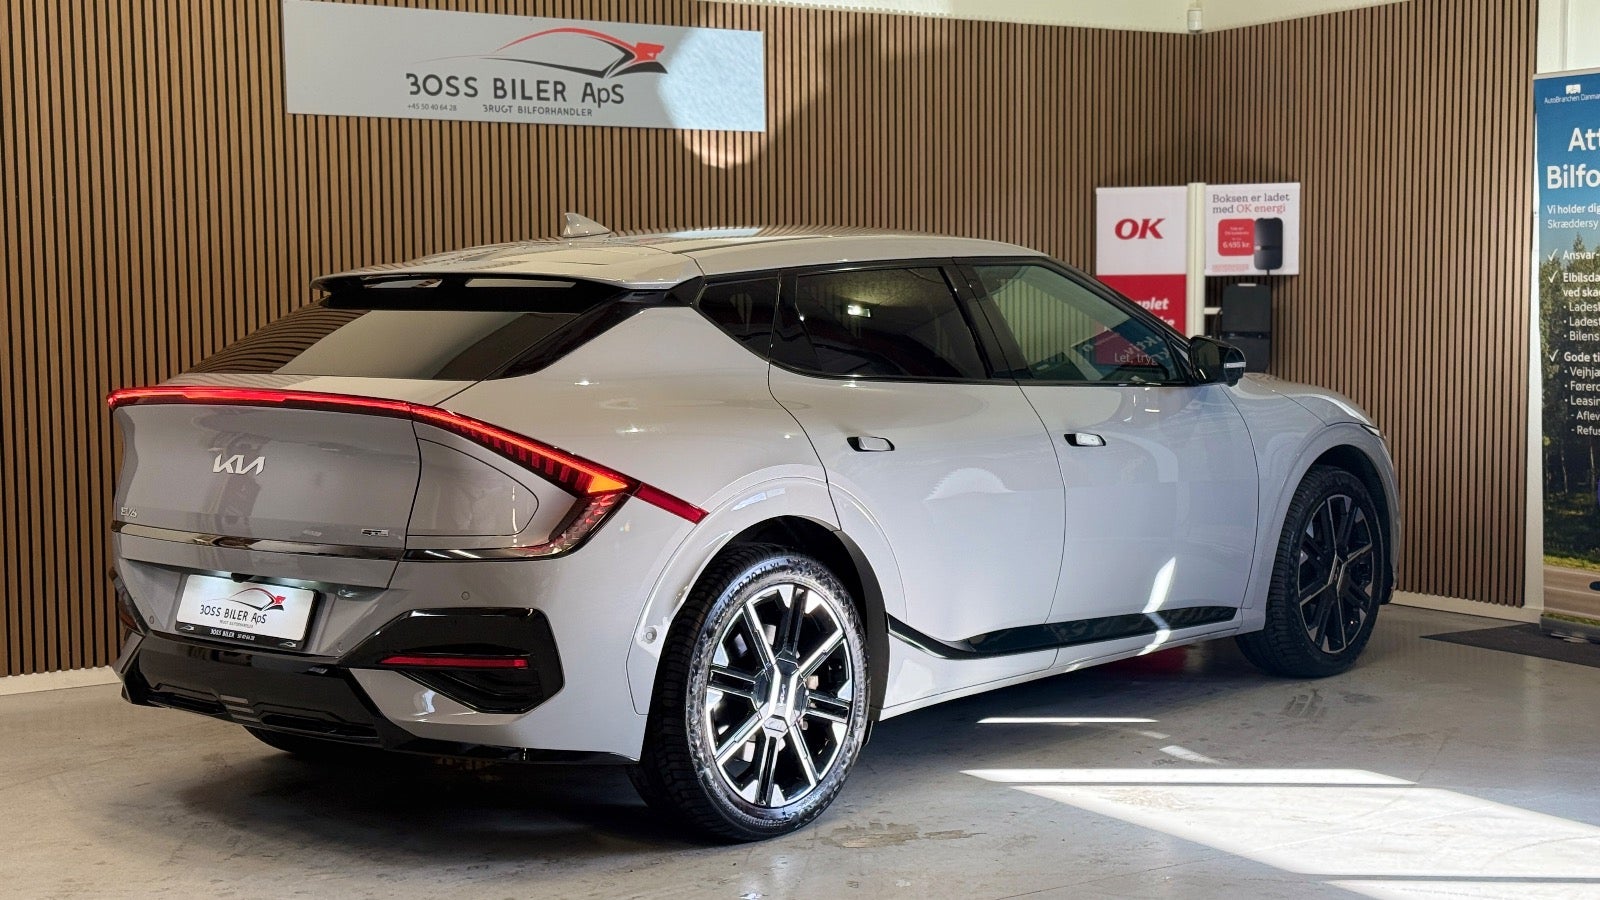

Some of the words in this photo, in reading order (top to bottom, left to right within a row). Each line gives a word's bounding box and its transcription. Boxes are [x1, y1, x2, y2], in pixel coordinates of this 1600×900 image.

[493, 77, 567, 102] BILER
[581, 82, 625, 109] ApS
[1544, 95, 1580, 104] AutoBranchen
[407, 102, 420, 110] +45
[420, 103, 430, 111] 50
[517, 106, 593, 117] BILFORHANDLER
[1547, 163, 1600, 190] Bilfo
[1212, 193, 1249, 204] Boksen
[1250, 195, 1262, 203] er
[1263, 192, 1291, 202] ladet
[1212, 205, 1235, 214] med
[1236, 204, 1253, 213] OK
[1254, 203, 1287, 215] energi
[1546, 204, 1556, 215] Vi
[1557, 203, 1586, 215] holder
[1114, 218, 1166, 240] OK
[1547, 218, 1599, 231] Skræddersy
[1563, 287, 1580, 297] ved
[1569, 330, 1600, 341] Bilens
[1563, 351, 1591, 362] Gode
[212, 453, 266, 475] KIA
[223, 608, 249, 622] BILER
[250, 612, 268, 625] ApS
